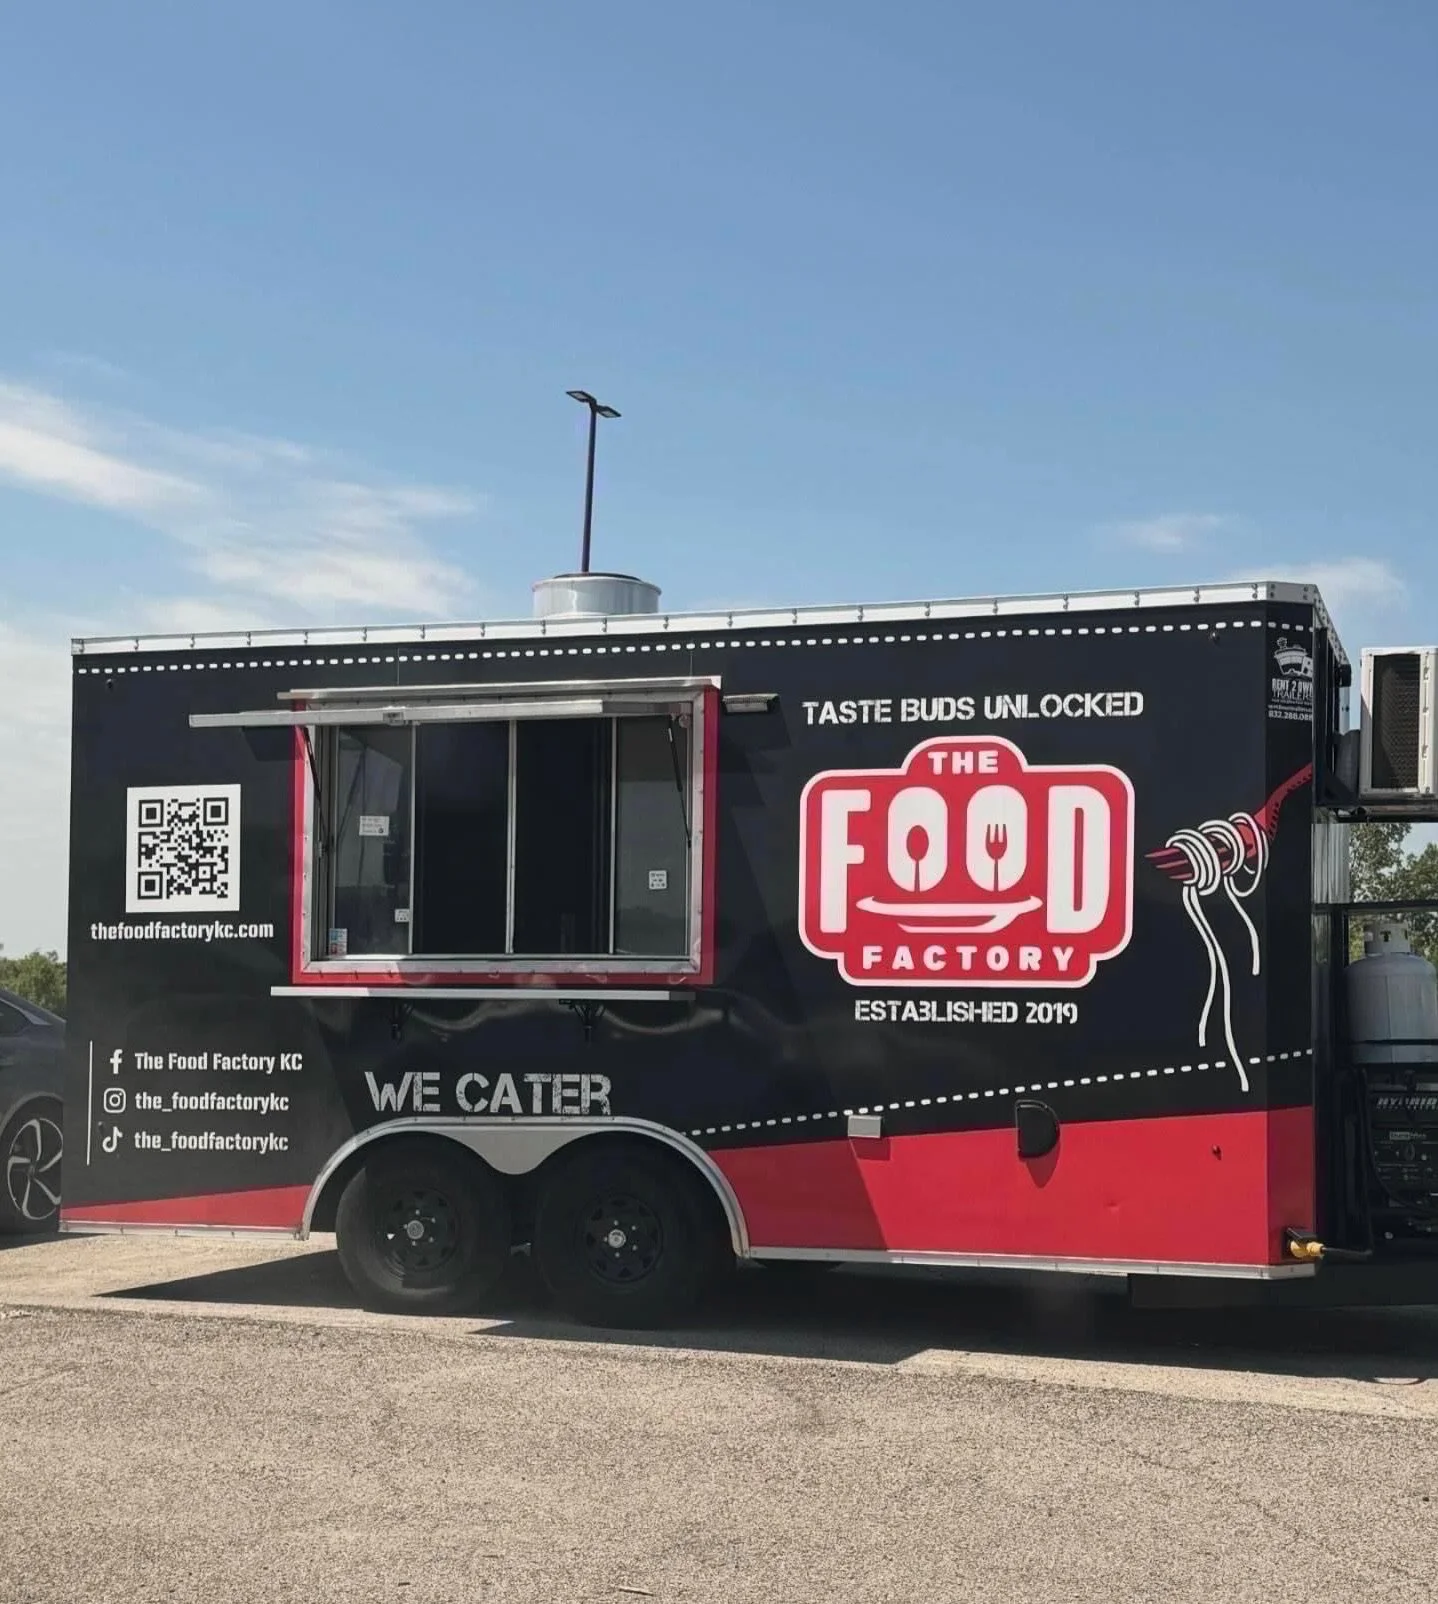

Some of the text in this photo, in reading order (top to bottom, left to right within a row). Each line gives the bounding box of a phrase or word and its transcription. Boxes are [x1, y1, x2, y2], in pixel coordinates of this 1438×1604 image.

[1291, 680, 1297, 692] 2
[802, 691, 1144, 725] TASTE BUDS UNLOCKED
[927, 750, 999, 775] THE
[819, 785, 1111, 934] FOOD
[90, 920, 274, 942] thefoodfactorykc.com
[862, 945, 1075, 972] FACTORY
[854, 999, 1078, 1025] ESTABLISHED 2019
[134, 1052, 303, 1074] The Food Factory KC
[135, 1092, 289, 1115] the_foodfactorykc
[364, 1071, 612, 1115] WE CATER
[134, 1131, 289, 1154] the_foodfactorykc
